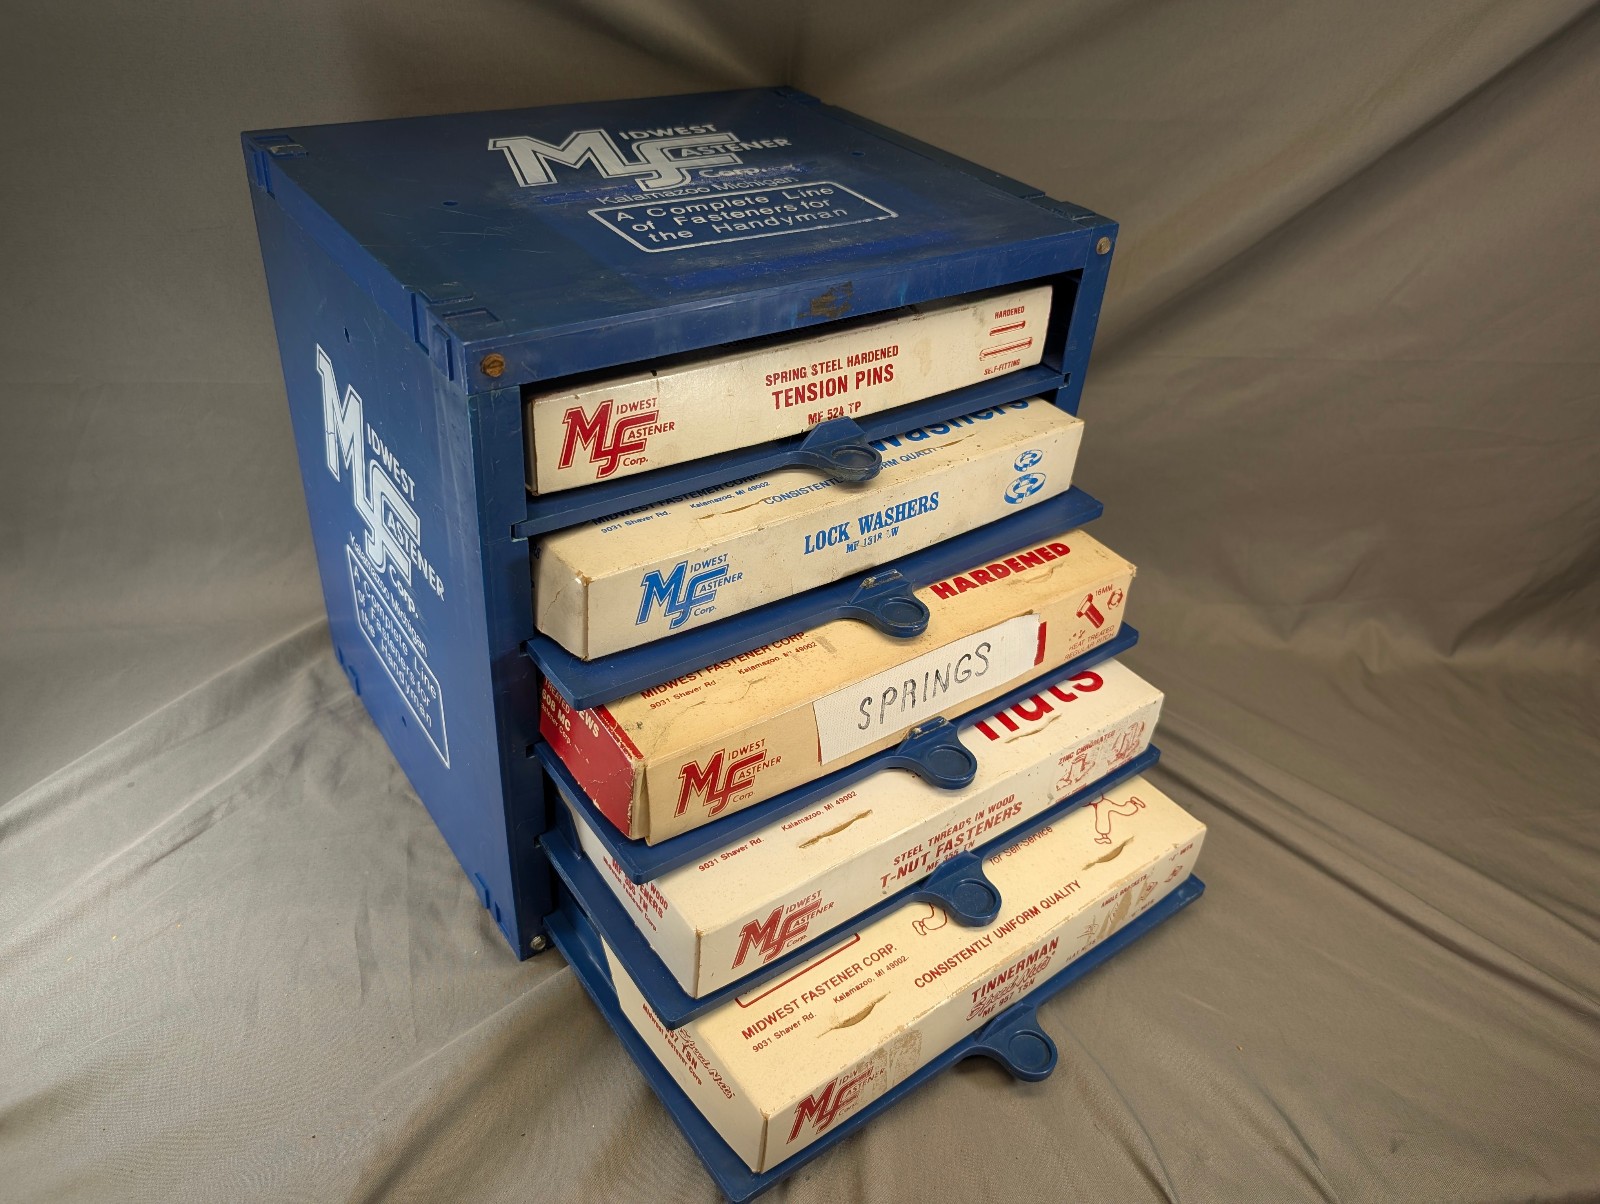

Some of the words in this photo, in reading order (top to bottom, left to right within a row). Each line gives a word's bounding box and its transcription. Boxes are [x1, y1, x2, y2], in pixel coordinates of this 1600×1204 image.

[596, 187, 710, 205] Kalamazoo
[711, 176, 799, 191] Michigan
[699, 167, 767, 178] Corp.
[617, 211, 634, 222] A
[647, 194, 769, 217] Complete
[781, 187, 835, 200] Line
[632, 220, 656, 232] of
[673, 203, 798, 226] Fasteners
[800, 200, 830, 210] for
[648, 230, 694, 243] the
[711, 208, 848, 234] Handyman
[995, 306, 1025, 319] HARDENED
[765, 366, 807, 387] SPRING
[811, 358, 844, 378] STEEL
[847, 345, 899, 368] HARDENED
[772, 374, 849, 410] TENSION
[855, 363, 894, 391] PINS
[808, 411, 824, 425] MF
[827, 406, 845, 420] 524
[848, 401, 862, 414] TP
[623, 456, 649, 468] Corp.
[593, 501, 657, 526] MIDWEST
[658, 484, 724, 507] FASTENER
[600, 523, 622, 535] 9031
[625, 515, 653, 527] Shaver
[655, 510, 672, 519] Rd.
[690, 493, 735, 509] Kalamazoo,
[735, 488, 746, 497] MI
[747, 481, 771, 492] 49002
[763, 475, 845, 506] CONSISTENTL
[804, 521, 851, 555] LOCK
[858, 491, 940, 536] WASHERS
[846, 540, 860, 553] MF
[886, 526, 900, 538] W
[389, 564, 419, 619] Corp.
[930, 542, 1071, 600] HARDENED
[354, 565, 361, 583] A
[363, 581, 408, 655] Complete
[414, 656, 437, 699] Line
[693, 606, 717, 617] Corp.
[357, 589, 366, 607] of
[371, 606, 415, 685] Fasteners
[417, 680, 431, 706] for
[361, 608, 376, 638] the
[381, 639, 432, 728] Handyman
[640, 669, 704, 700] MIDWEST
[705, 644, 772, 675] FASTENER
[772, 631, 809, 649] CORP.
[650, 697, 670, 711] 9031
[674, 685, 703, 700] Shaver
[795, 641, 817, 653] 49002
[857, 641, 992, 731] SPRINGS
[558, 709, 572, 732] MC
[698, 858, 719, 872] 9031
[720, 845, 748, 861] Shaver
[749, 837, 765, 847] Rd.
[781, 810, 824, 832] Kalamazoo,
[824, 803, 834, 812] MI
[835, 790, 857, 805] 49002
[880, 851, 931, 889] T-NUT
[935, 801, 1023, 858] FASTENERS
[893, 843, 923, 867] STEEL
[928, 817, 971, 847] THREADS
[974, 809, 985, 824] IN
[986, 793, 1015, 814] WOOD
[989, 850, 1003, 866] for
[1005, 825, 1053, 857] Self-Service
[926, 858, 940, 872] MF
[650, 882, 669, 910] WOOD
[914, 935, 993, 989] CONSISTENTLY
[993, 906, 1040, 938] UNIFORM
[1040, 879, 1082, 910] QUALITY
[741, 998, 800, 1040] MIDWEST
[801, 963, 864, 1004] FASTENER
[862, 943, 897, 968] CORP.
[972, 936, 1060, 1003] TINNERMAN
[1018, 977, 1036, 993] TSN
[752, 1037, 772, 1053] 9031
[774, 1020, 801, 1040] Shaver
[802, 1011, 817, 1023] Rd.
[832, 977, 875, 1004] Kalamazoo,
[876, 968, 885, 979] MI
[886, 956, 908, 972] 49002
